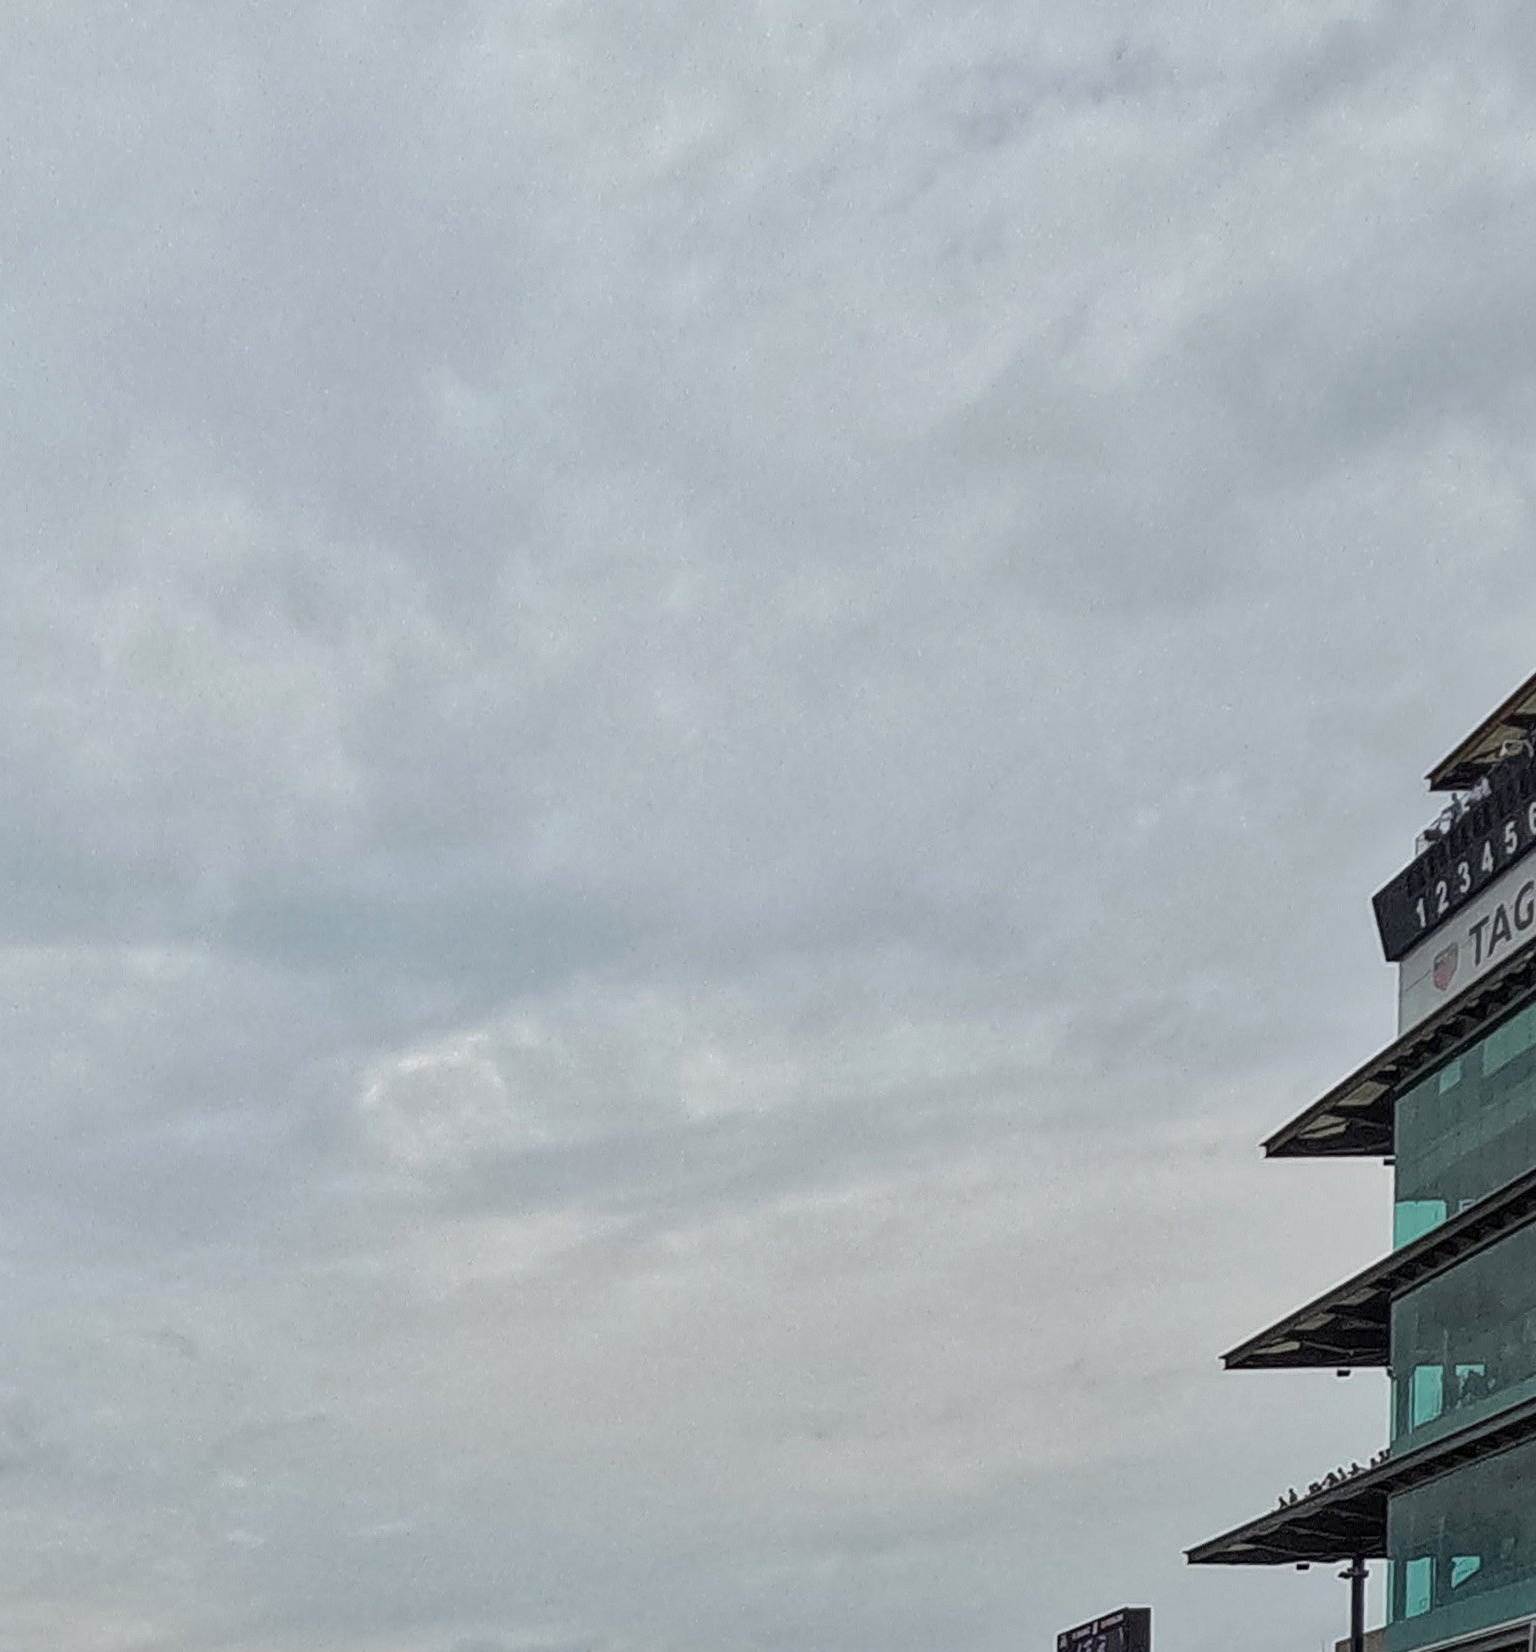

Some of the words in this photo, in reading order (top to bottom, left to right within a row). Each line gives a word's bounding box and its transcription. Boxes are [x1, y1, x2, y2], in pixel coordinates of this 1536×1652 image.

[1415, 897, 1427, 928] 1
[1435, 880, 1449, 915] 2
[1457, 861, 1471, 893] 3
[1481, 840, 1494, 873] 4
[1504, 820, 1518, 853] 5
